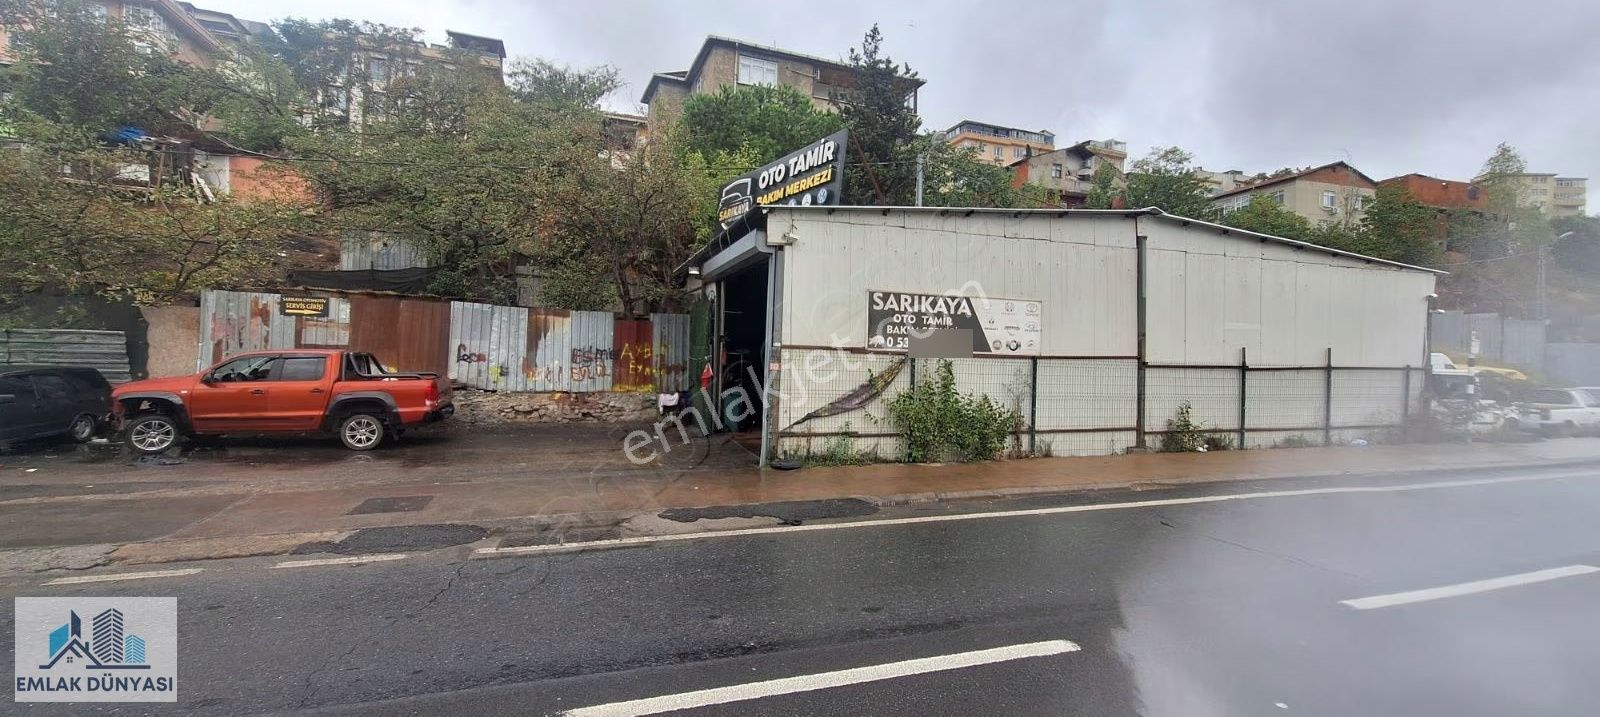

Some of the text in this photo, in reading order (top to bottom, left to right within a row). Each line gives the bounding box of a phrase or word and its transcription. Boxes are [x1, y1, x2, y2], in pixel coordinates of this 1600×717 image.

[758, 138, 836, 190] OTO TAMİR
[756, 164, 833, 206] BAKIM MERKEZİ
[872, 291, 972, 316] SARIKAYA
[893, 313, 954, 326] OTO TAMİR
[886, 336, 894, 348] 0
